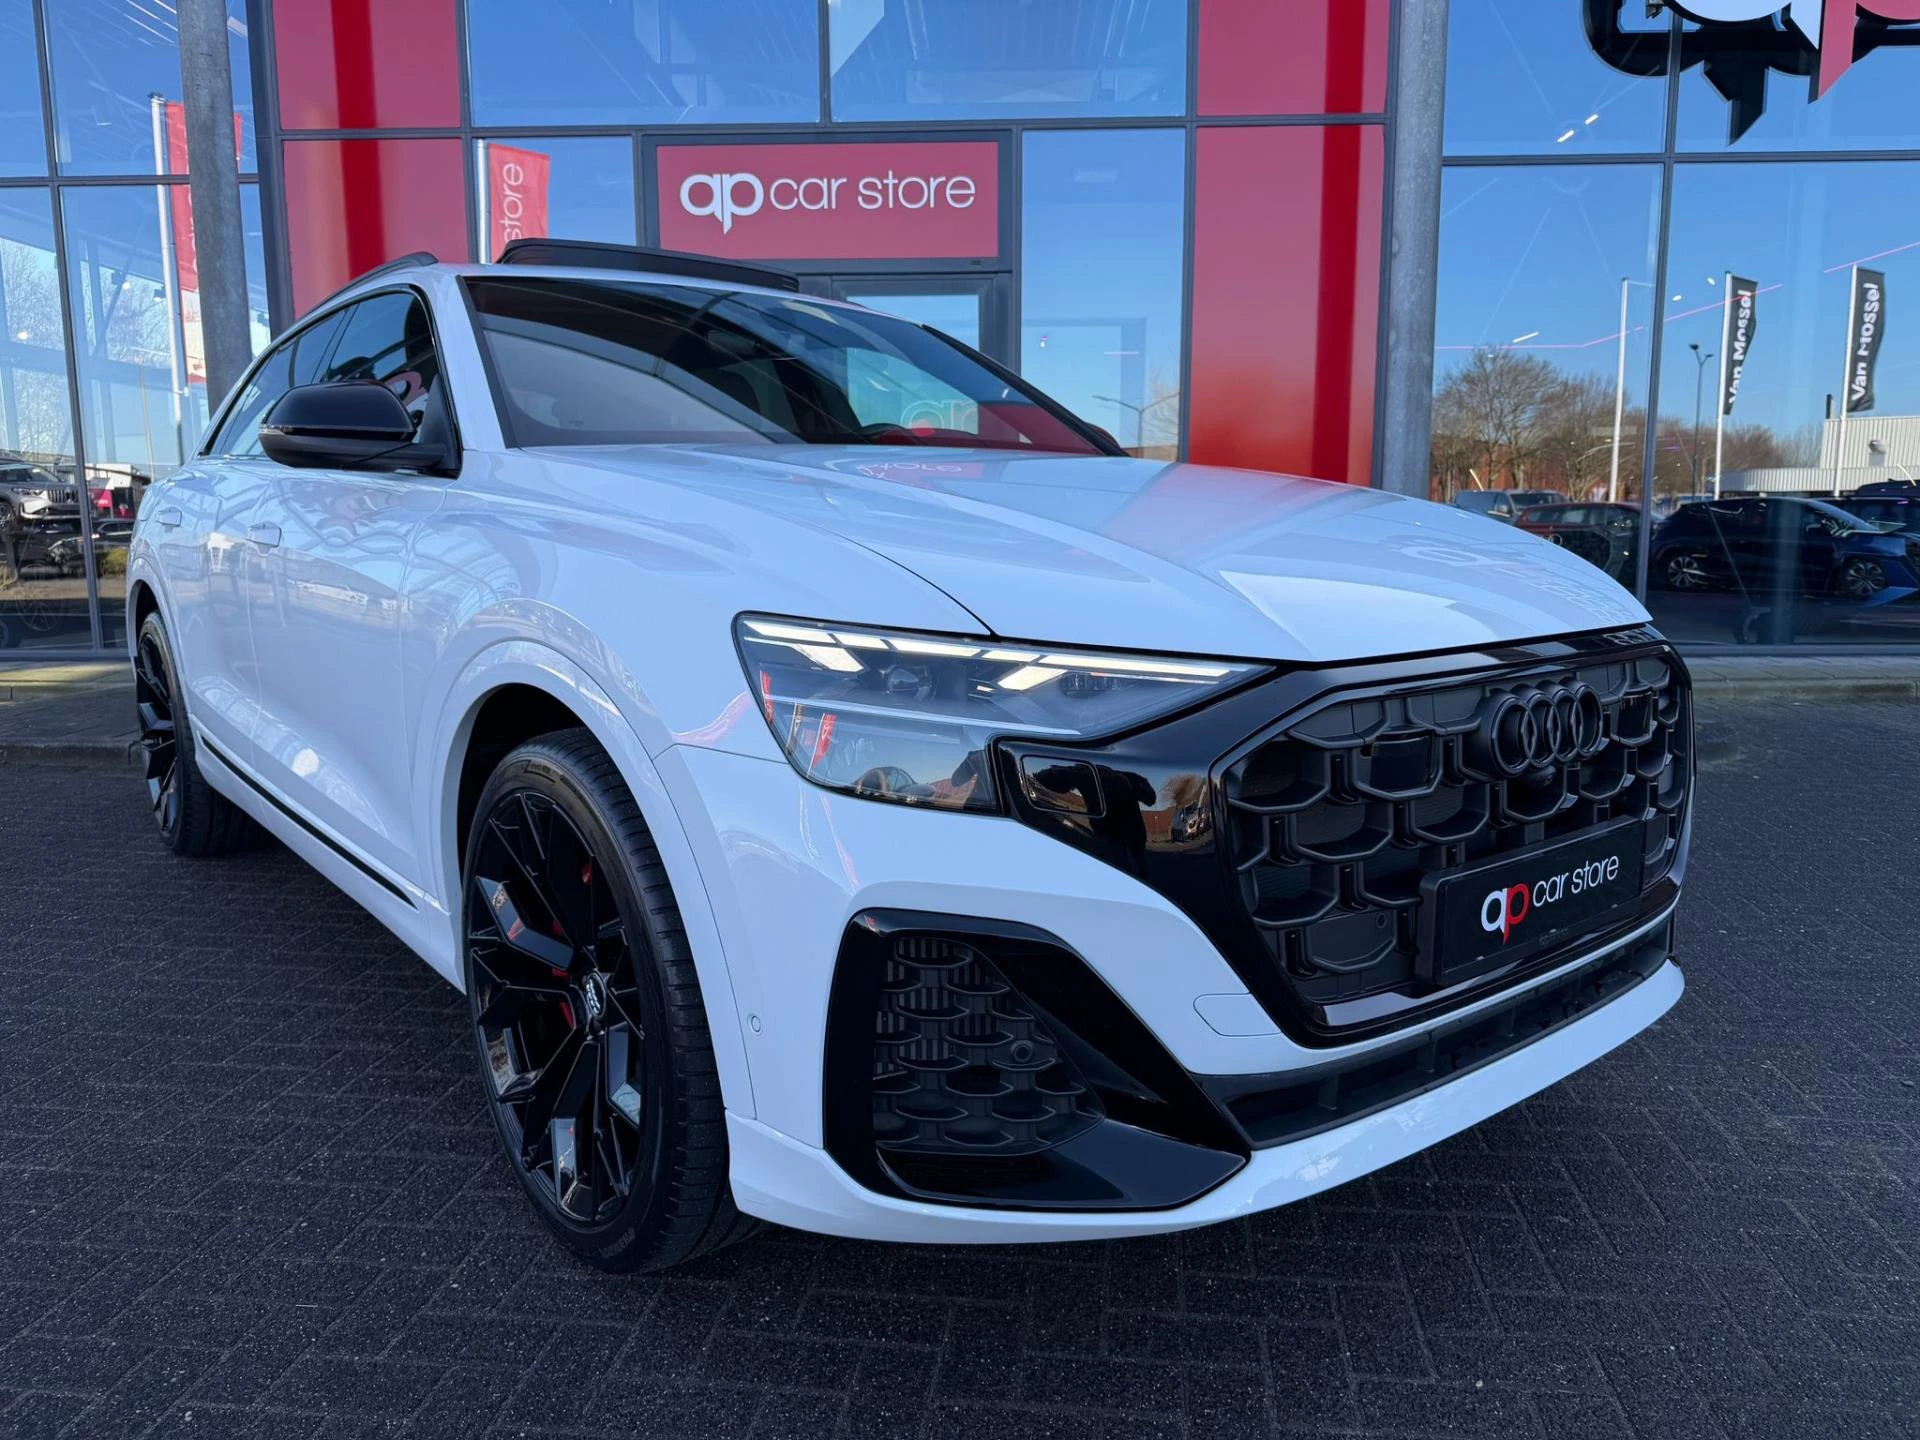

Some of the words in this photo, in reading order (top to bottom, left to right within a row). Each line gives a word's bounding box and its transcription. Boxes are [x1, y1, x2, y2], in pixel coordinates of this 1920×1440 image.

[500, 163, 523, 243] store
[680, 172, 764, 235] ap
[769, 177, 847, 211] car
[857, 170, 976, 210] store
[1857, 282, 1880, 356] Mossel
[1851, 362, 1867, 401] Van
[1481, 883, 1530, 945] ap
[1532, 872, 1570, 907] car
[1571, 855, 1619, 894] store
